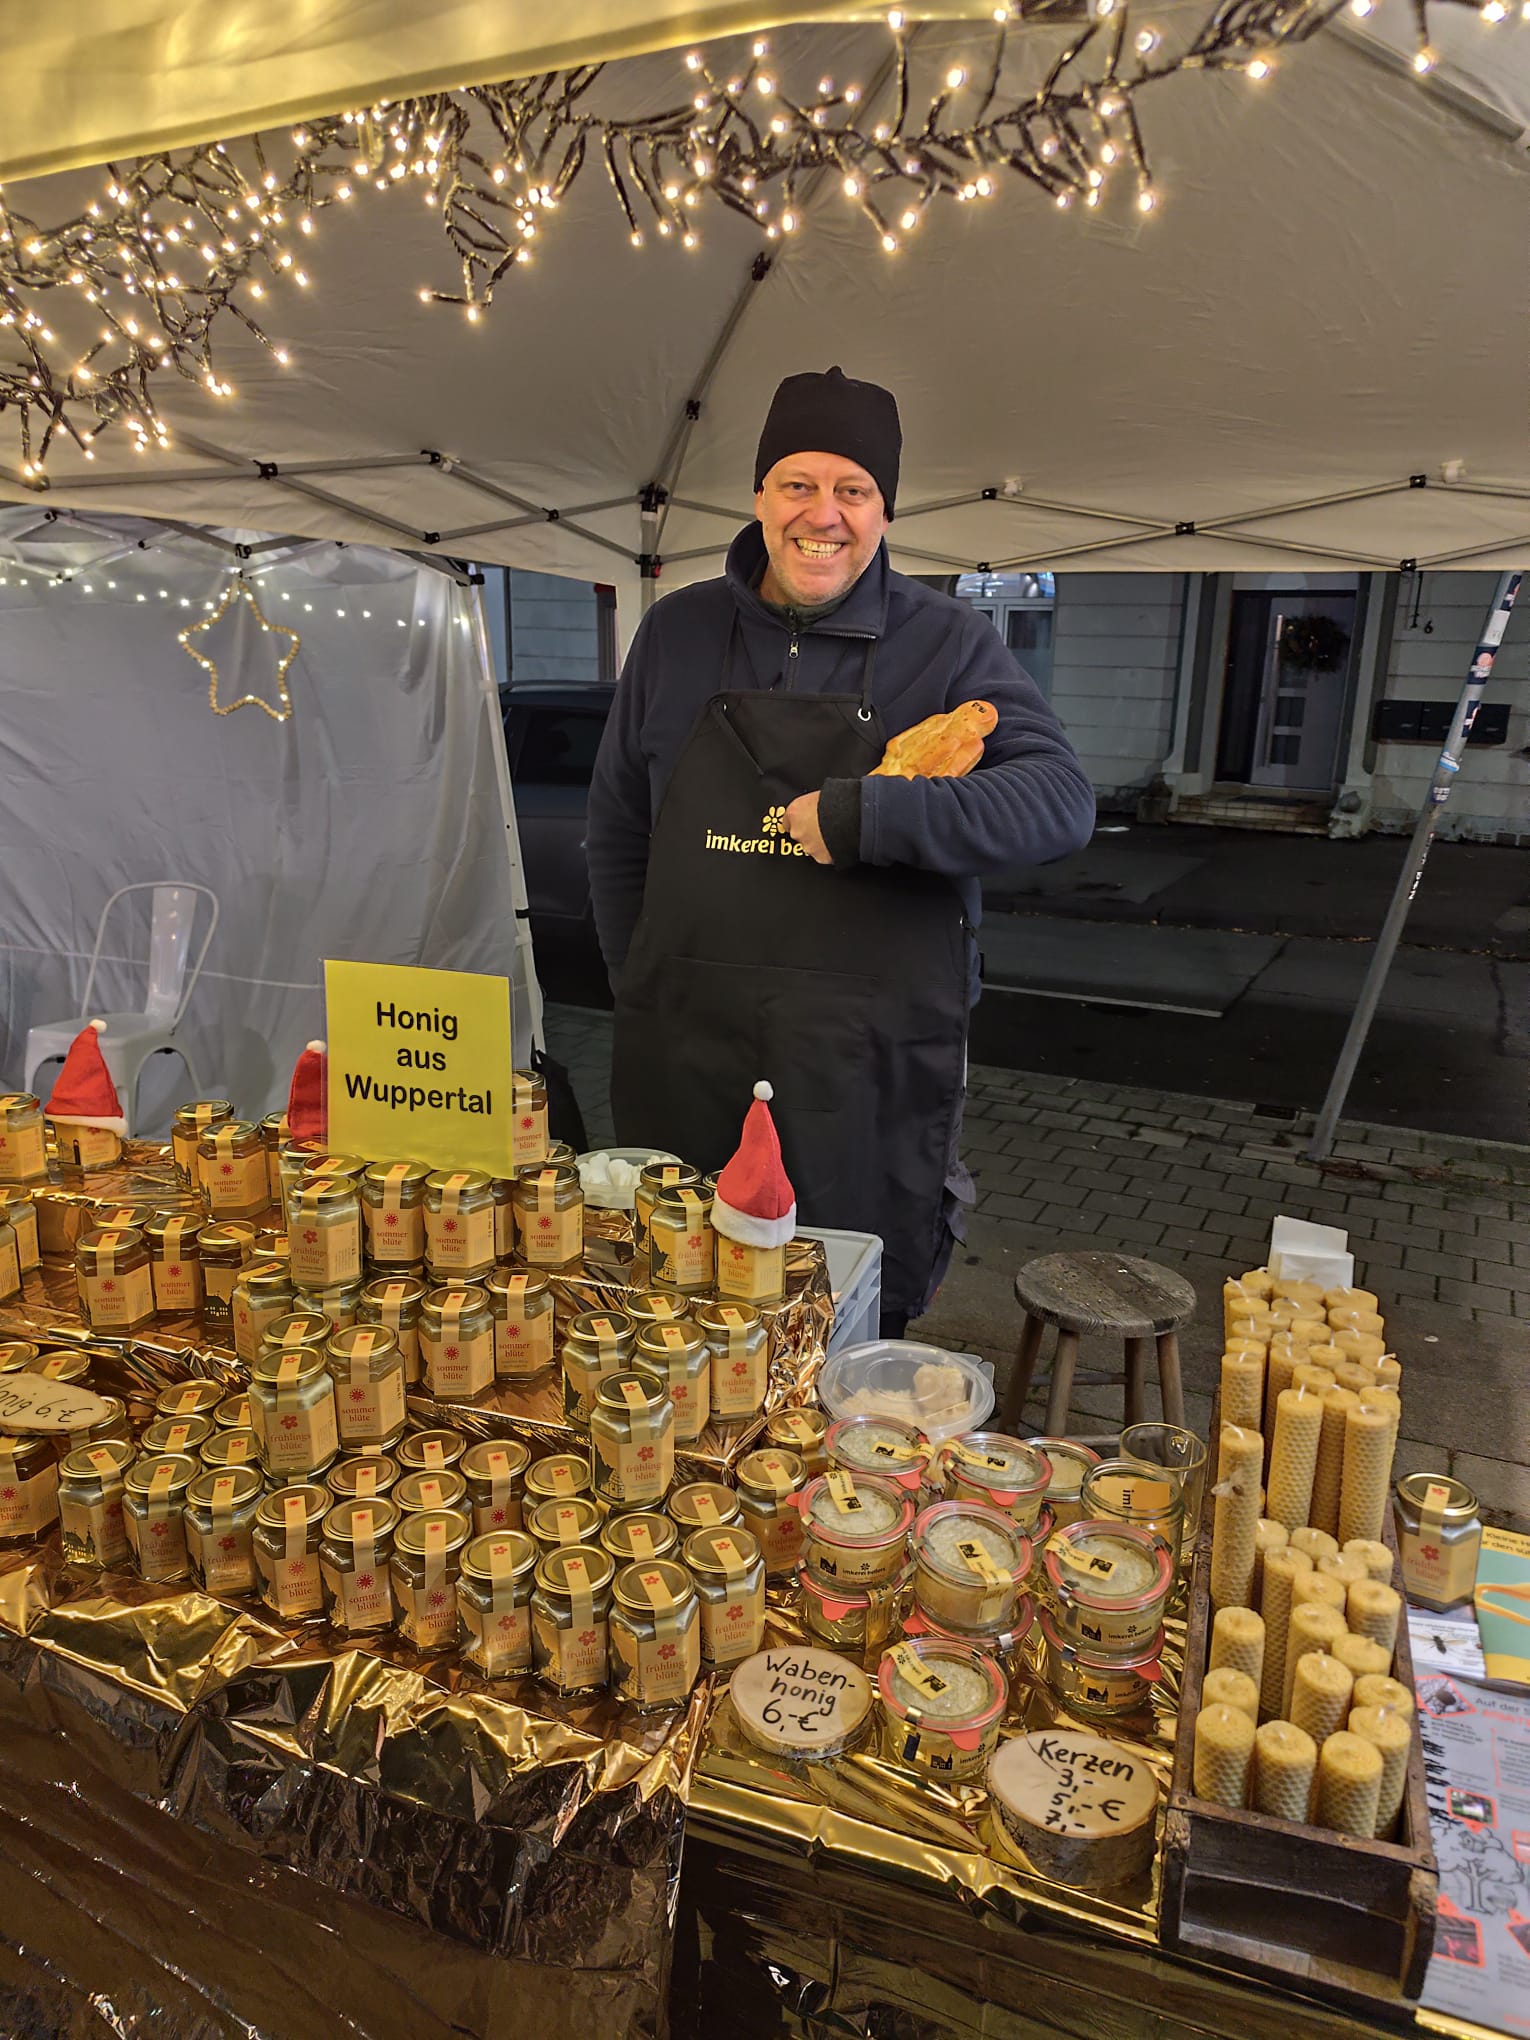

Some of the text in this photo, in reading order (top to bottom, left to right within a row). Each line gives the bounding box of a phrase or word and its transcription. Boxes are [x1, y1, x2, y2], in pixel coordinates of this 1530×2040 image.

[706, 830, 810, 856] imkerei be
[376, 1002, 458, 1040] Honig
[396, 1048, 446, 1070] aus
[345, 1074, 492, 1115] Wuppertal
[376, 1230, 408, 1238] sommer
[382, 1238, 402, 1246] blüte
[436, 1237, 467, 1245] sommer
[536, 1240, 555, 1248] blüte
[442, 1244, 462, 1252] blüte
[505, 1348, 525, 1357] blüte
[436, 1364, 469, 1372] sommer
[442, 1371, 464, 1380] blüte
[342, 1406, 376, 1414] sommer
[350, 1413, 370, 1422] blüte
[280, 1577, 318, 1590] sommer
[289, 1588, 312, 1598] blüte
[349, 1591, 386, 1604] sommer
[357, 1601, 381, 1612] blüte
[715, 1620, 755, 1635] frühlings
[725, 1630, 747, 1641] blüte
[646, 1658, 688, 1674] frühlings
[656, 1669, 680, 1681] blüte
[767, 1654, 856, 1690] Waben-
[770, 1677, 836, 1716] honig
[1475, 1697, 1496, 1708] Auf
[1038, 1738, 1134, 1781] Kerzen
